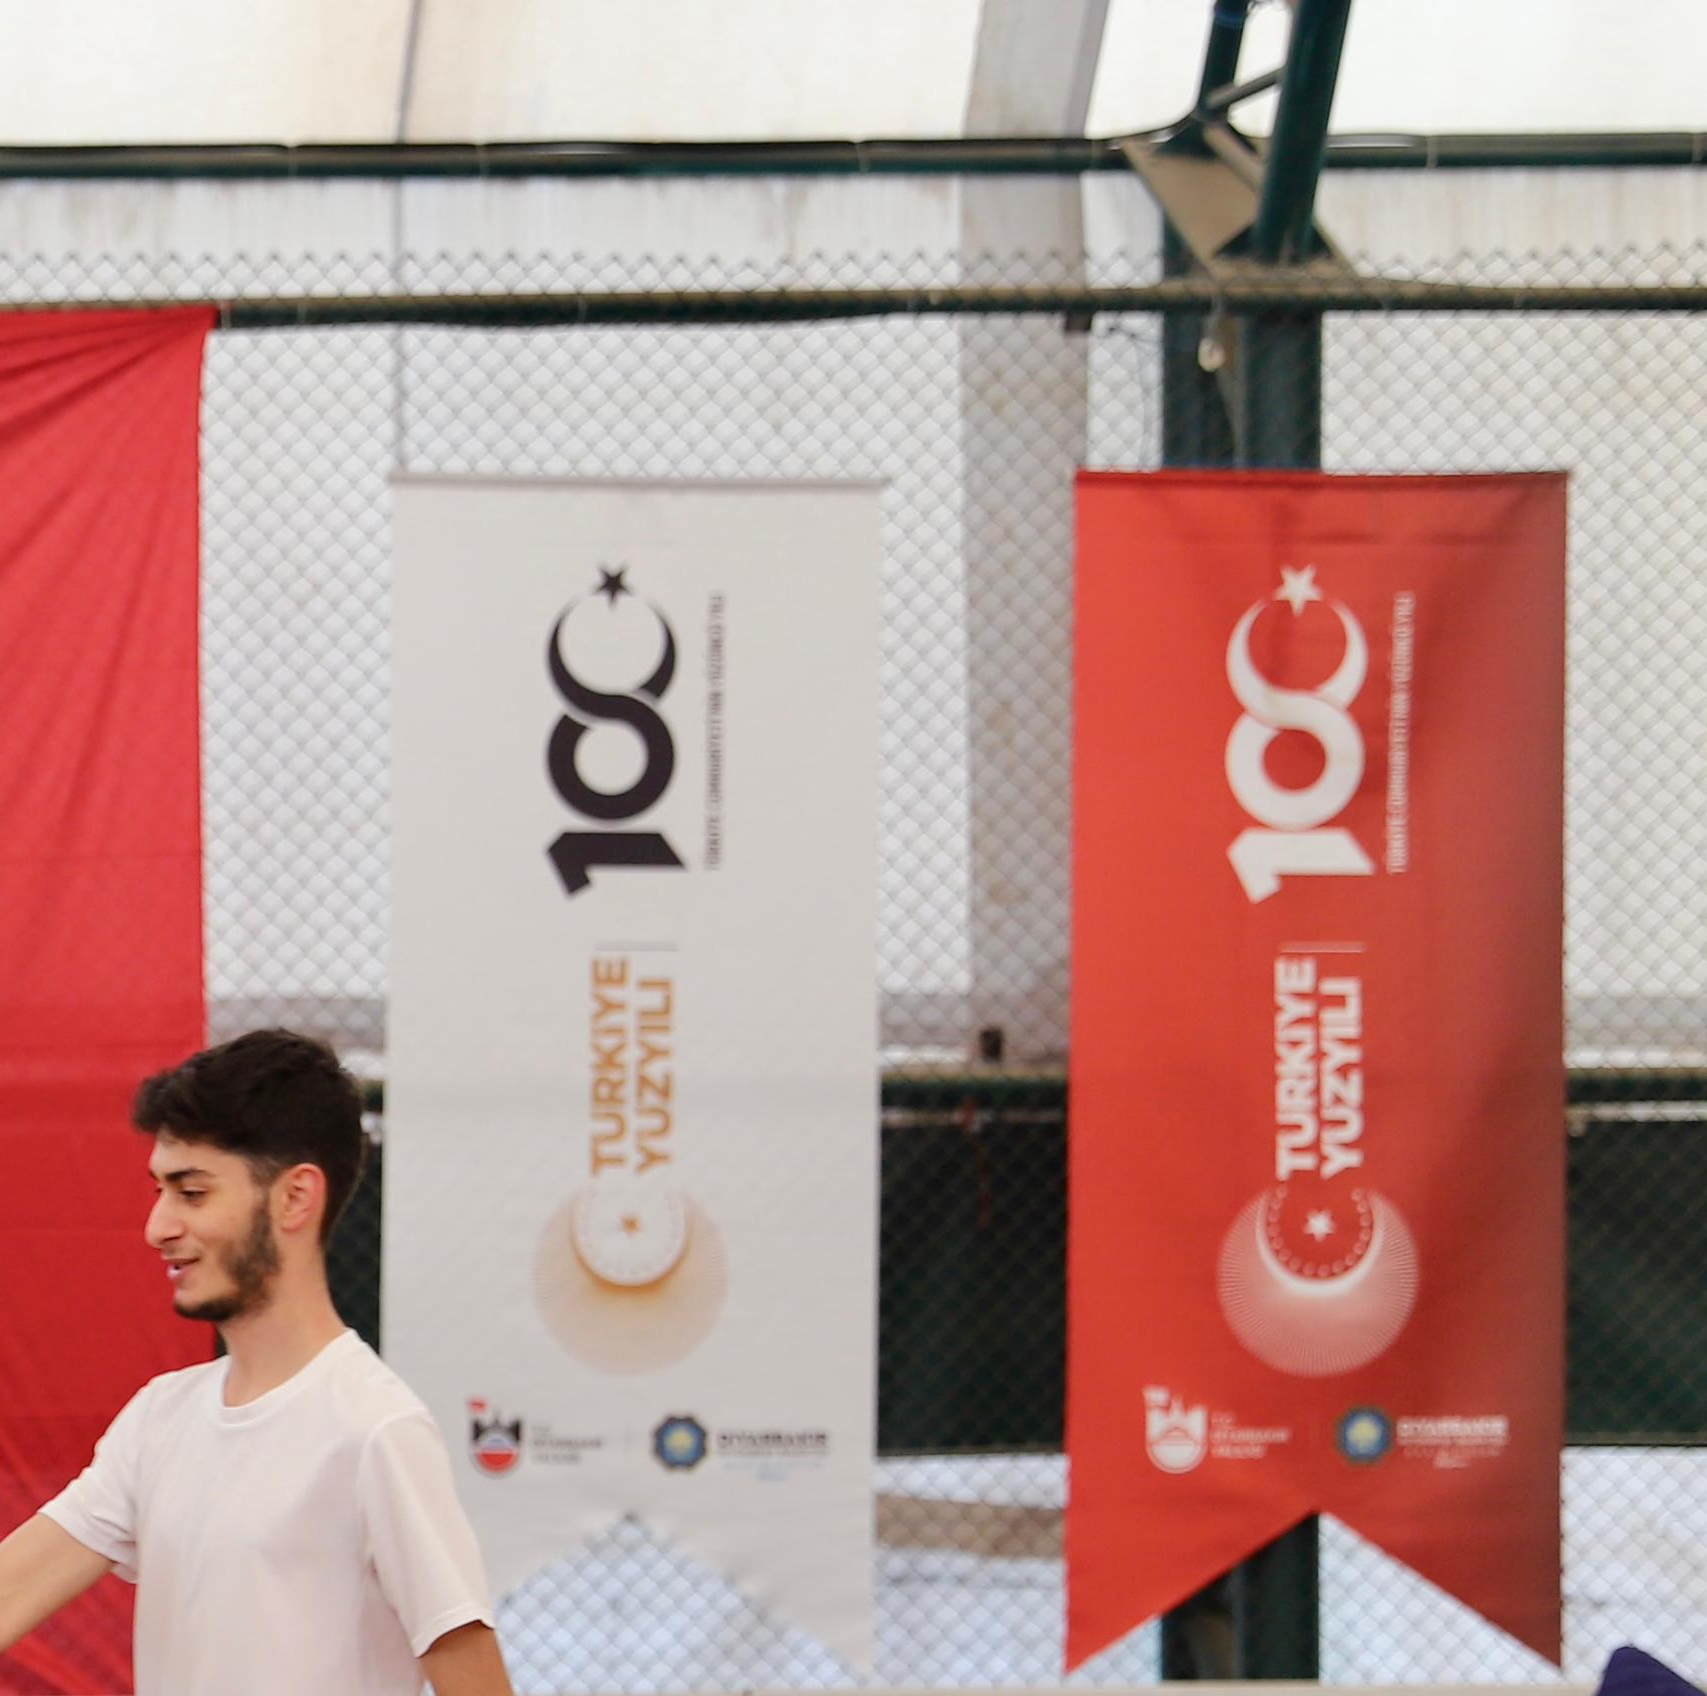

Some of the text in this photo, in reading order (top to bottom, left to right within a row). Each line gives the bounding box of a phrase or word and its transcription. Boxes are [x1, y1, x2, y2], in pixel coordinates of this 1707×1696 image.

[592, 956, 628, 1177] TÜRKİYE
[636, 978, 674, 1176] YÜZYILI
[1274, 956, 1318, 1180] TÜRKİYE
[1320, 977, 1365, 1179] YÜZYILI
